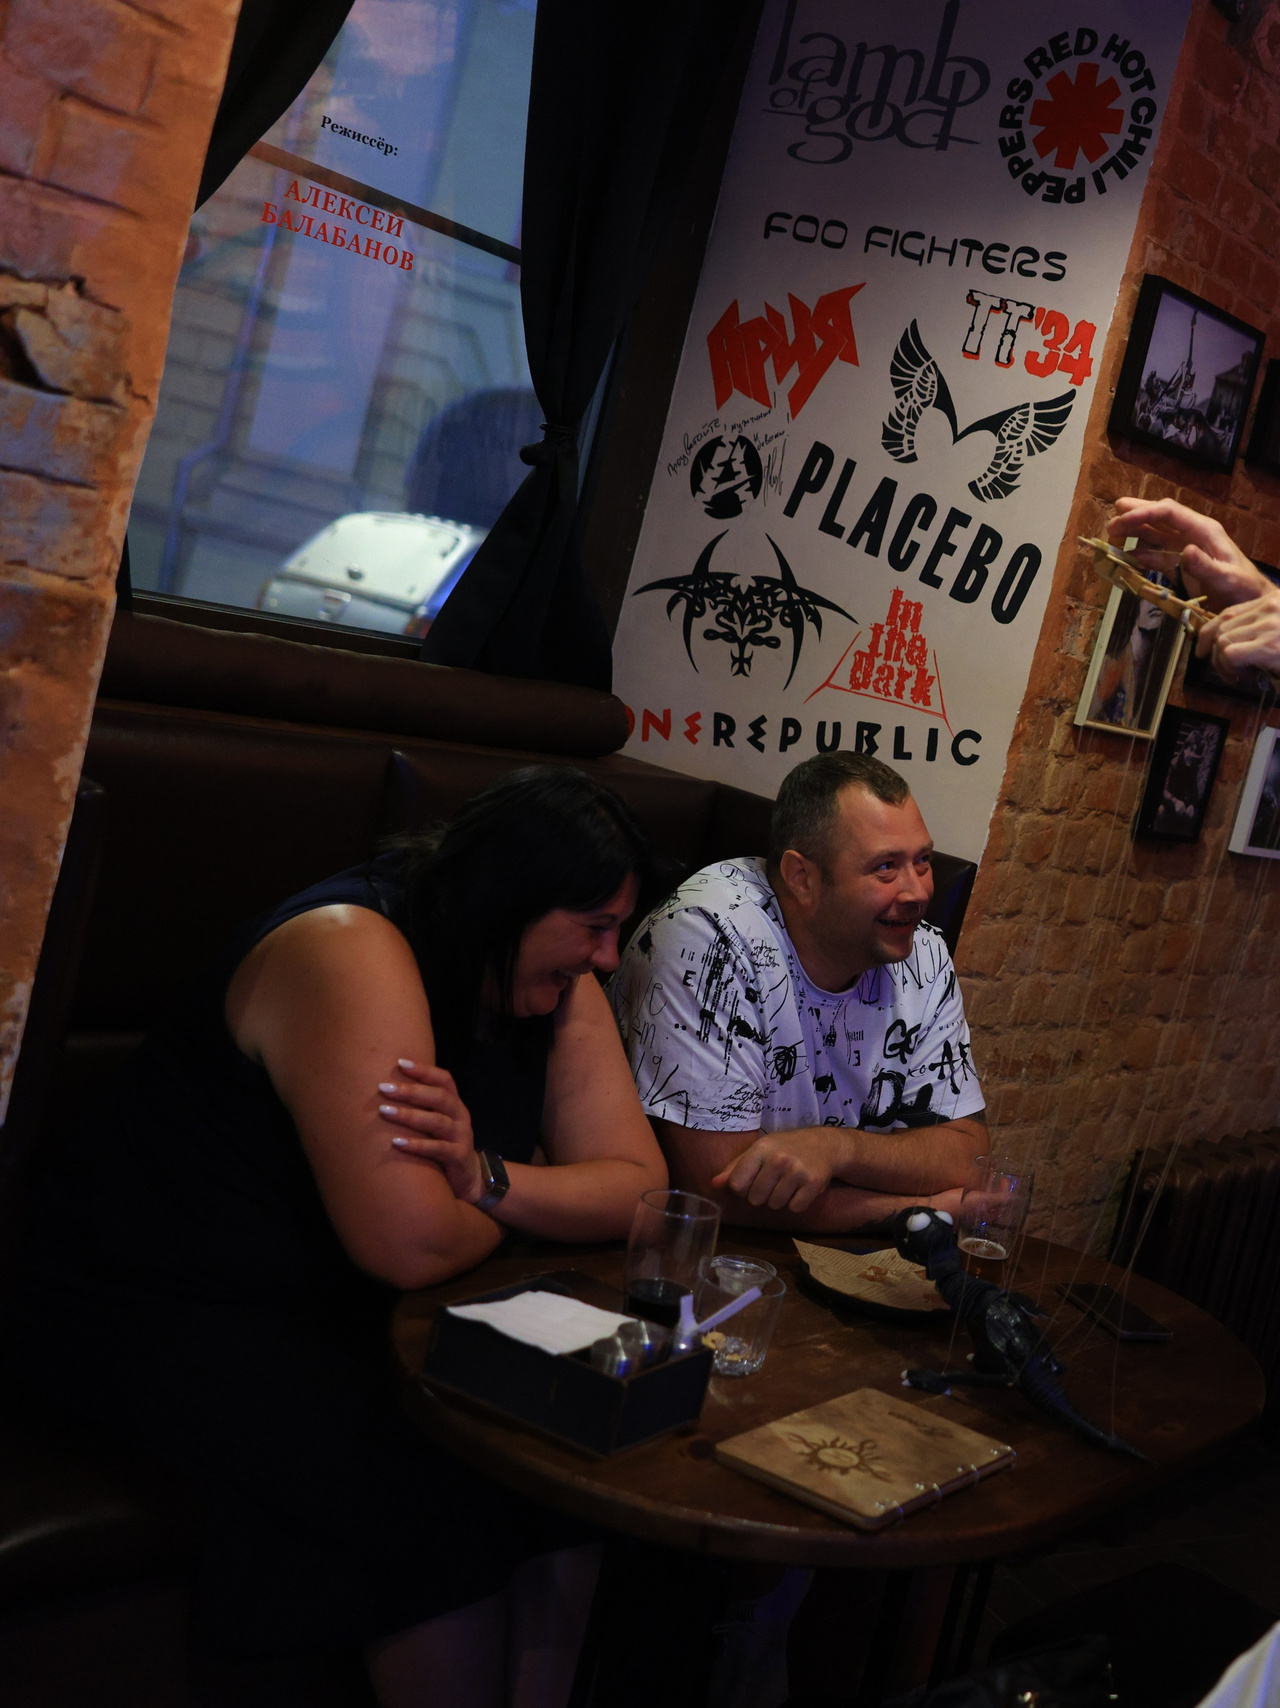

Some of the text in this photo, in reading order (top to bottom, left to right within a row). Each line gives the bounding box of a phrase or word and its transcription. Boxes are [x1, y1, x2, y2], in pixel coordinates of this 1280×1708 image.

[320, 115, 399, 156] Режиссёр:
[998, 27, 1158, 204] RED HOT CHILI PEPPERS
[260, 201, 416, 272] БАЛАБАНОВ
[283, 180, 406, 239] АЛЕКСЕЙ
[763, 211, 1068, 282] FOO FIGHTERS
[782, 440, 1043, 625] PLACEBO
